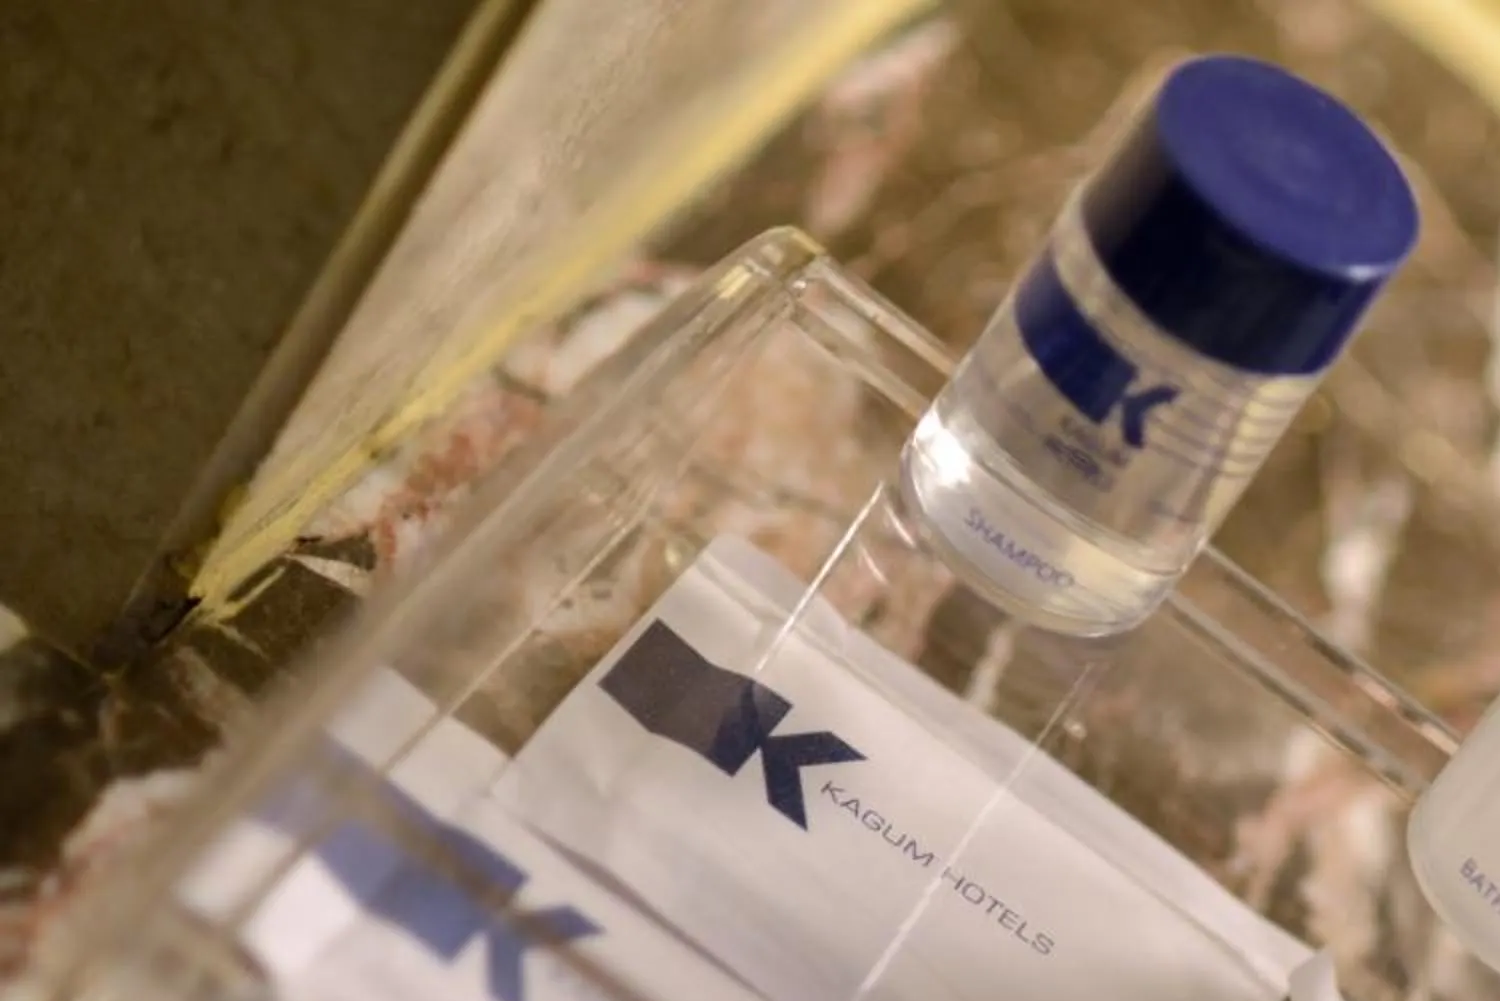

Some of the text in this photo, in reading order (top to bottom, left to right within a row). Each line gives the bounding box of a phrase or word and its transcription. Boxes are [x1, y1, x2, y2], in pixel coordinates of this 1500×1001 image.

[964, 506, 1075, 587] SHAMPOO
[820, 780, 1055, 956] KAGUM HOTELS
